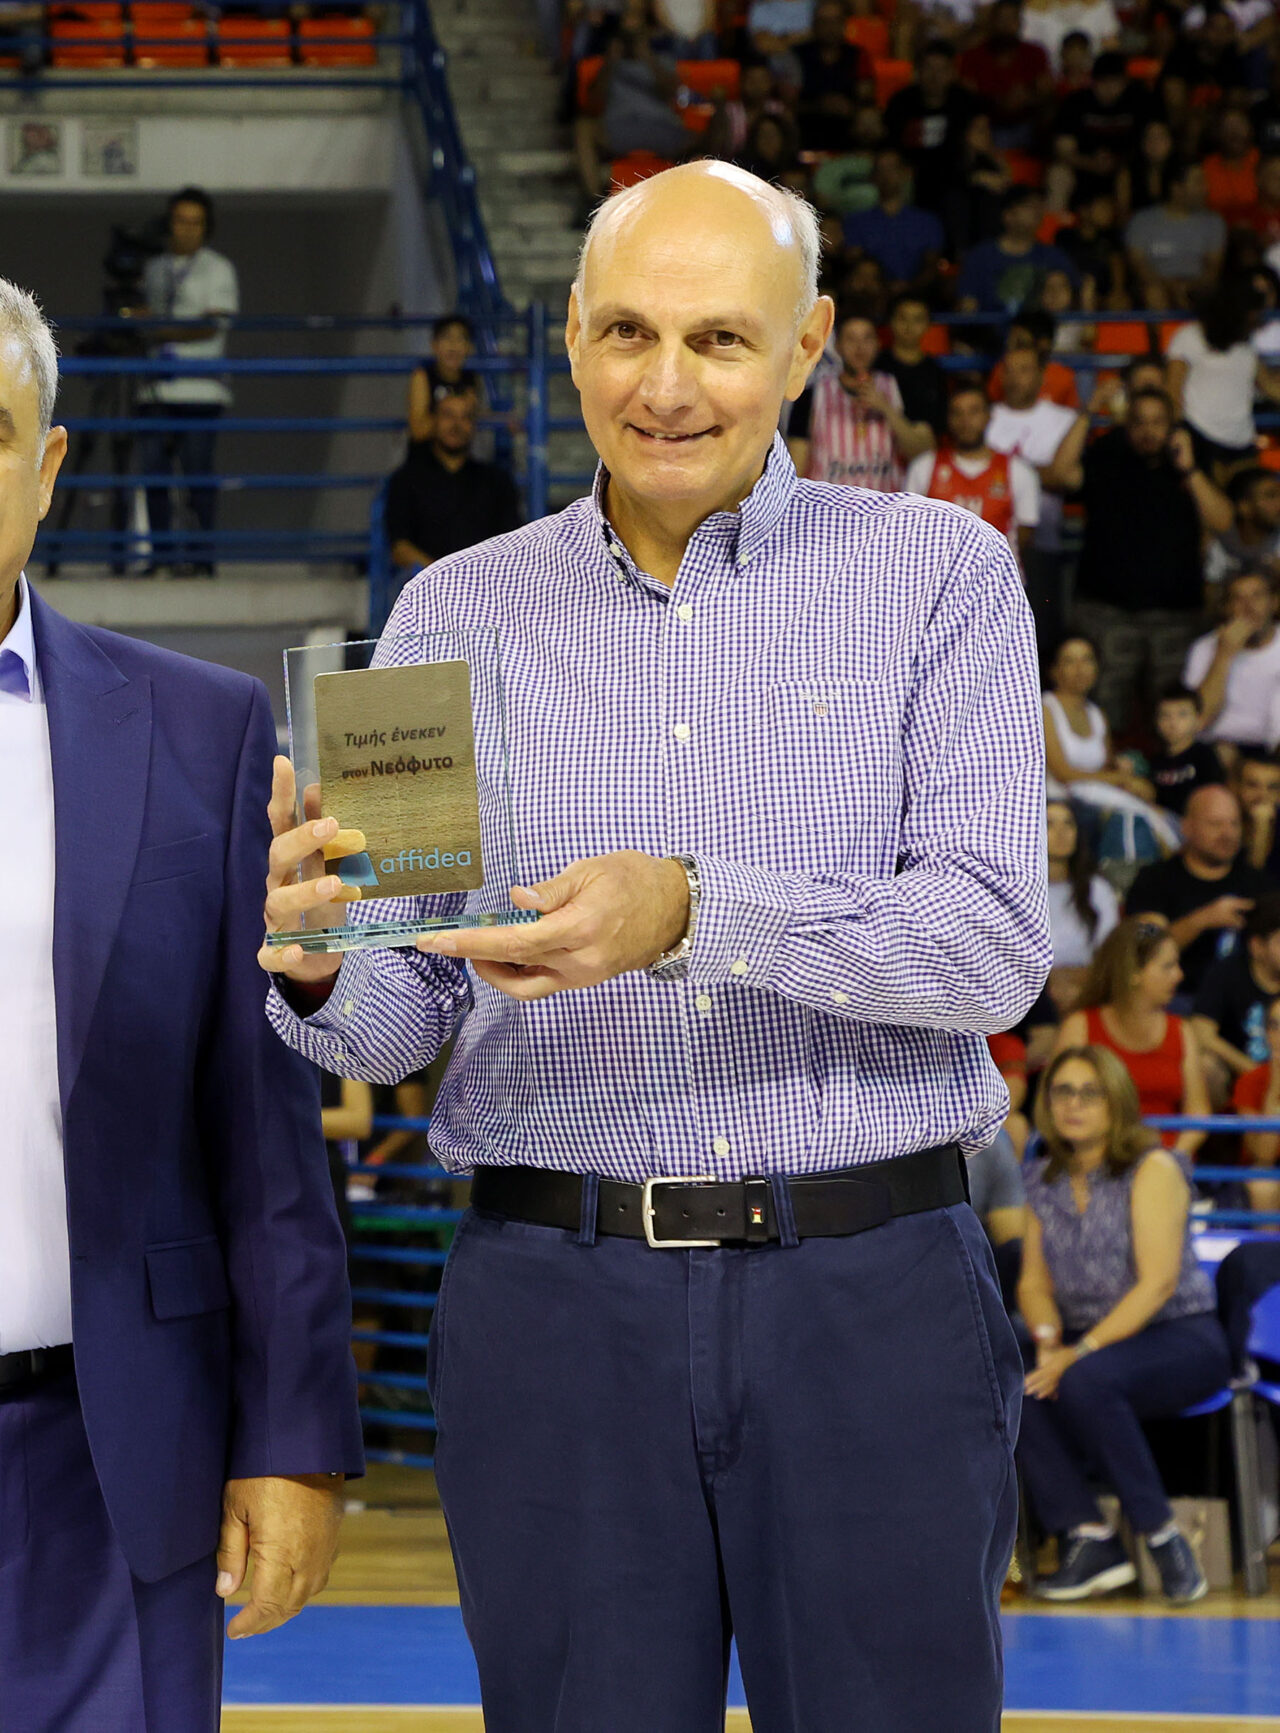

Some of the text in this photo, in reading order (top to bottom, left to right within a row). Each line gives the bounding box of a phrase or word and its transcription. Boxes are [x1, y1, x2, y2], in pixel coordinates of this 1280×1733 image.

[344, 726, 446, 749] Τιμής ένεκεν
[342, 755, 453, 779] στον Νεόφυτο
[380, 847, 472, 874] affidea
